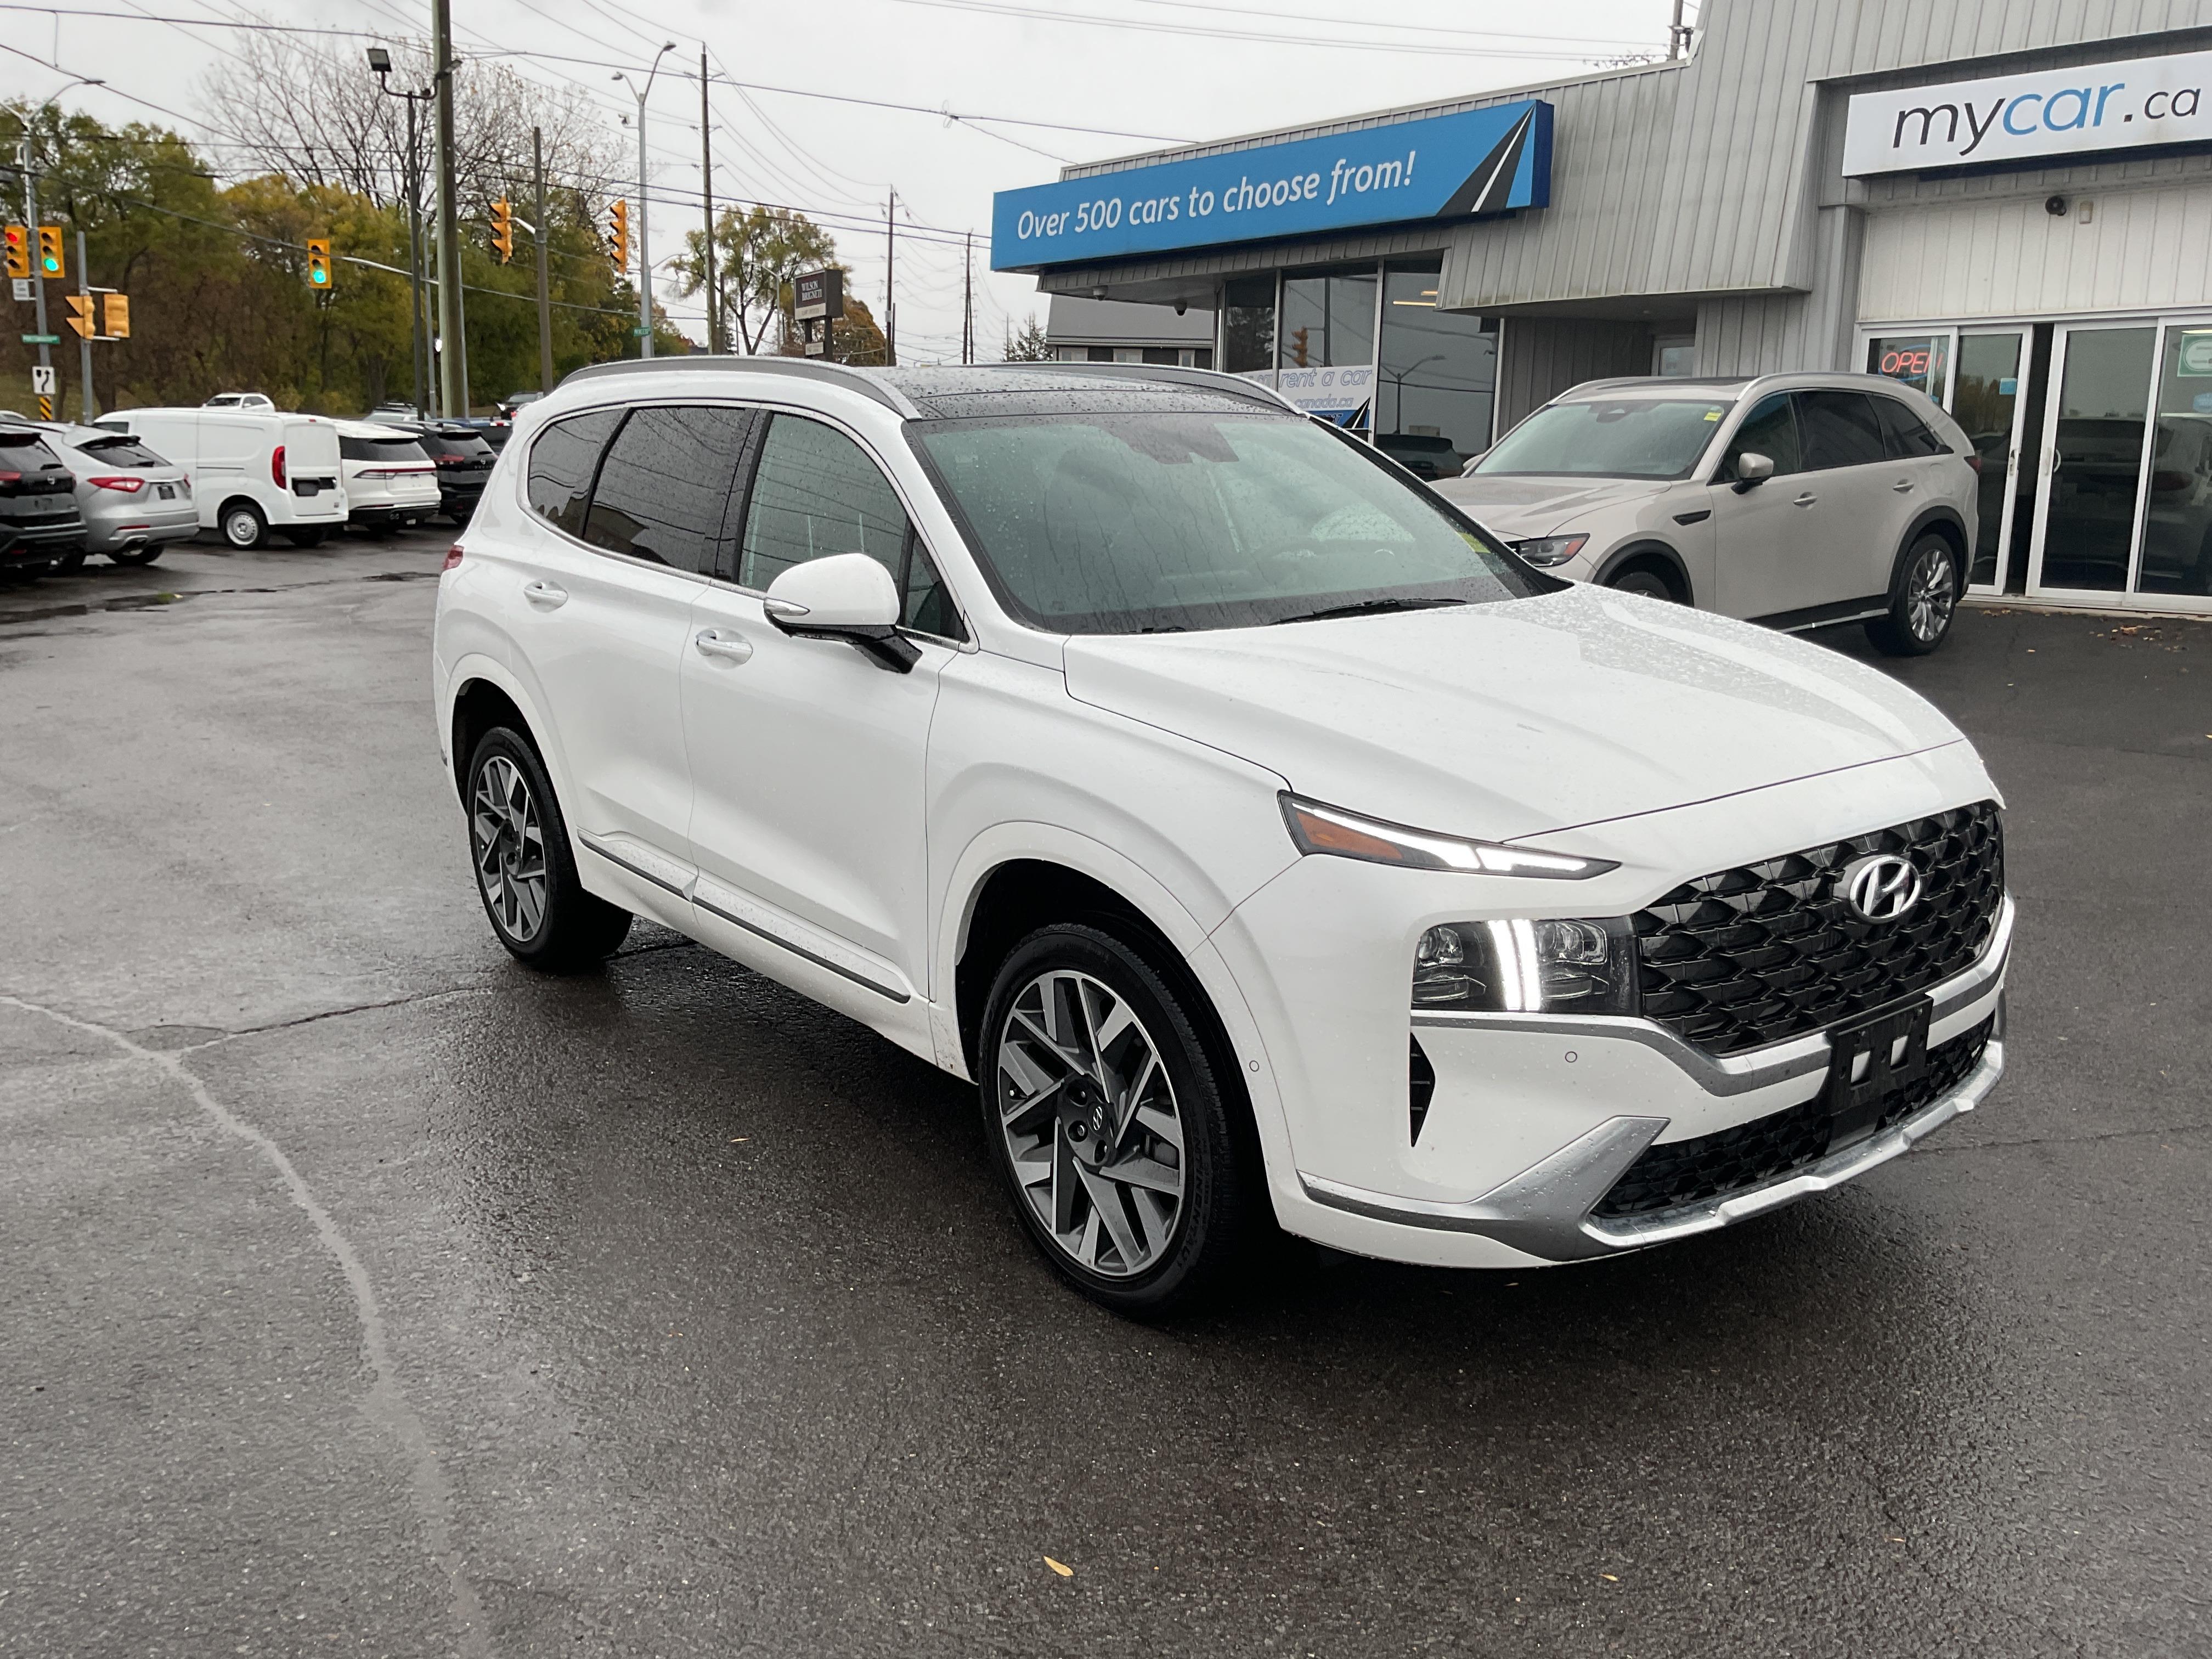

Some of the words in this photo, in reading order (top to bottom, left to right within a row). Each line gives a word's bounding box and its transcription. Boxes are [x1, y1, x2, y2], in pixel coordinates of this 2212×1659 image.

[1893, 83, 2201, 156] mycar.ca
[1018, 211, 1070, 240] Over
[1074, 198, 1121, 233] 500
[1129, 196, 1180, 225] cars
[1188, 187, 1215, 217] to
[1223, 173, 1320, 212] choose
[1326, 150, 1416, 206] from!
[1279, 368, 1317, 388] rent
[1322, 371, 1335, 386] a
[1340, 370, 1373, 386] car
